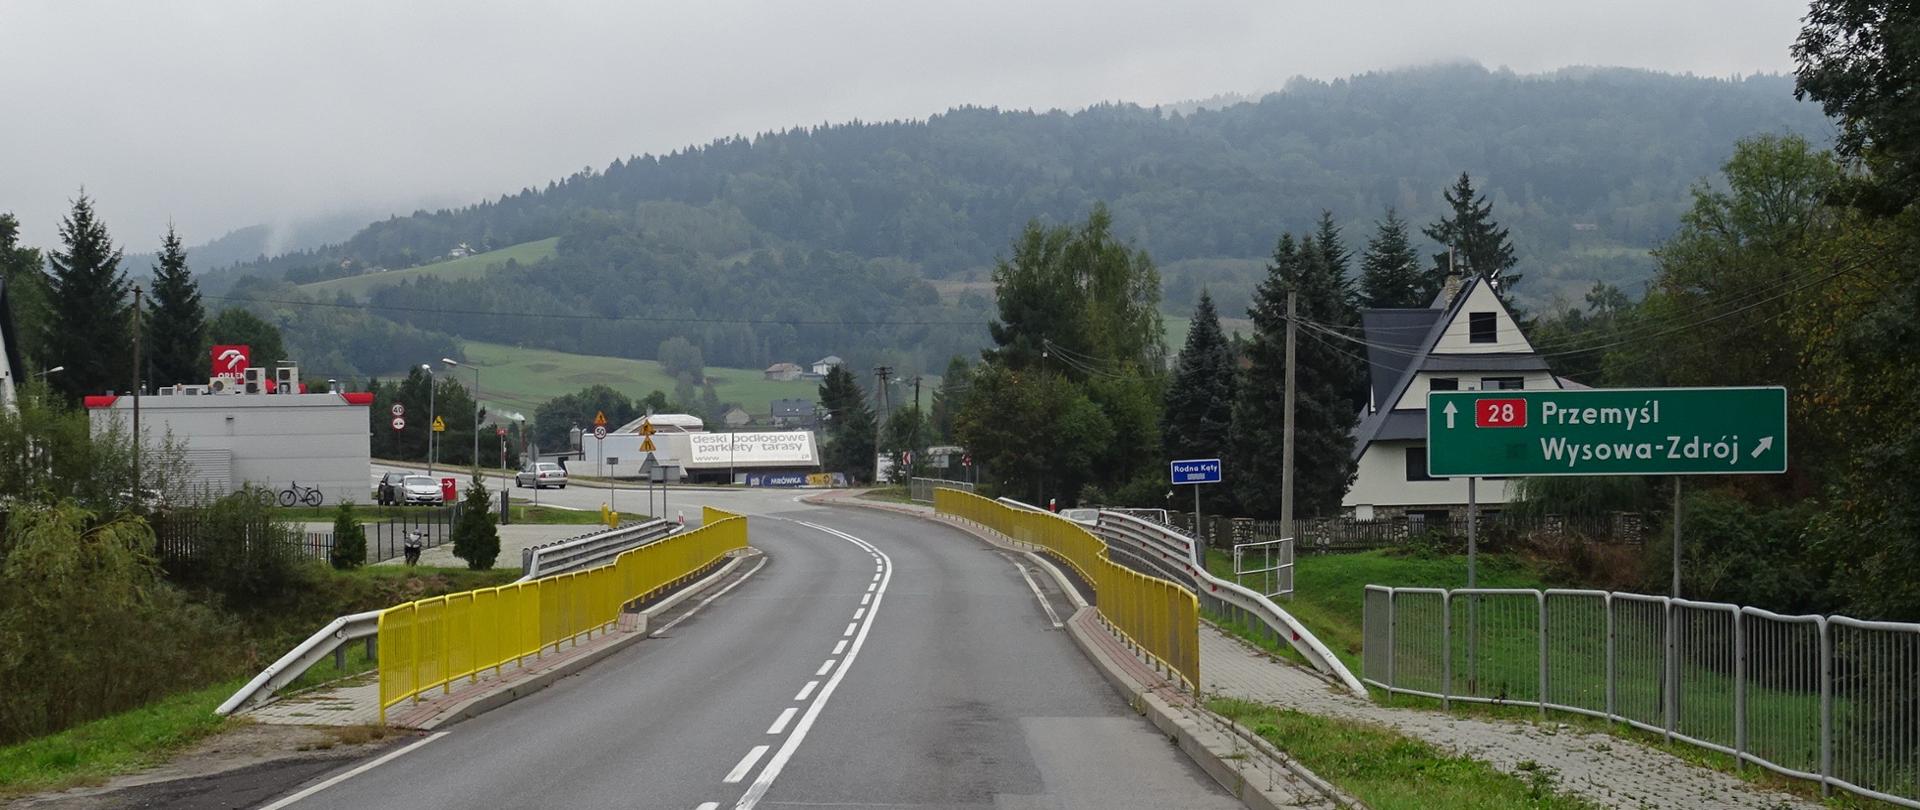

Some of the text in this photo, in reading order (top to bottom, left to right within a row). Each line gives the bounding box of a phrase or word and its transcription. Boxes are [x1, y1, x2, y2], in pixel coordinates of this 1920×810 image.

[1488, 404, 1514, 422] 28
[1542, 400, 1659, 430] Przemyśl
[597, 428, 604, 436] 50
[692, 435, 727, 443] deski
[698, 443, 802, 453] parkiety tarasy
[1540, 435, 1738, 467] Wysowa-Zdrój
[770, 476, 801, 485] MRÓWKA
